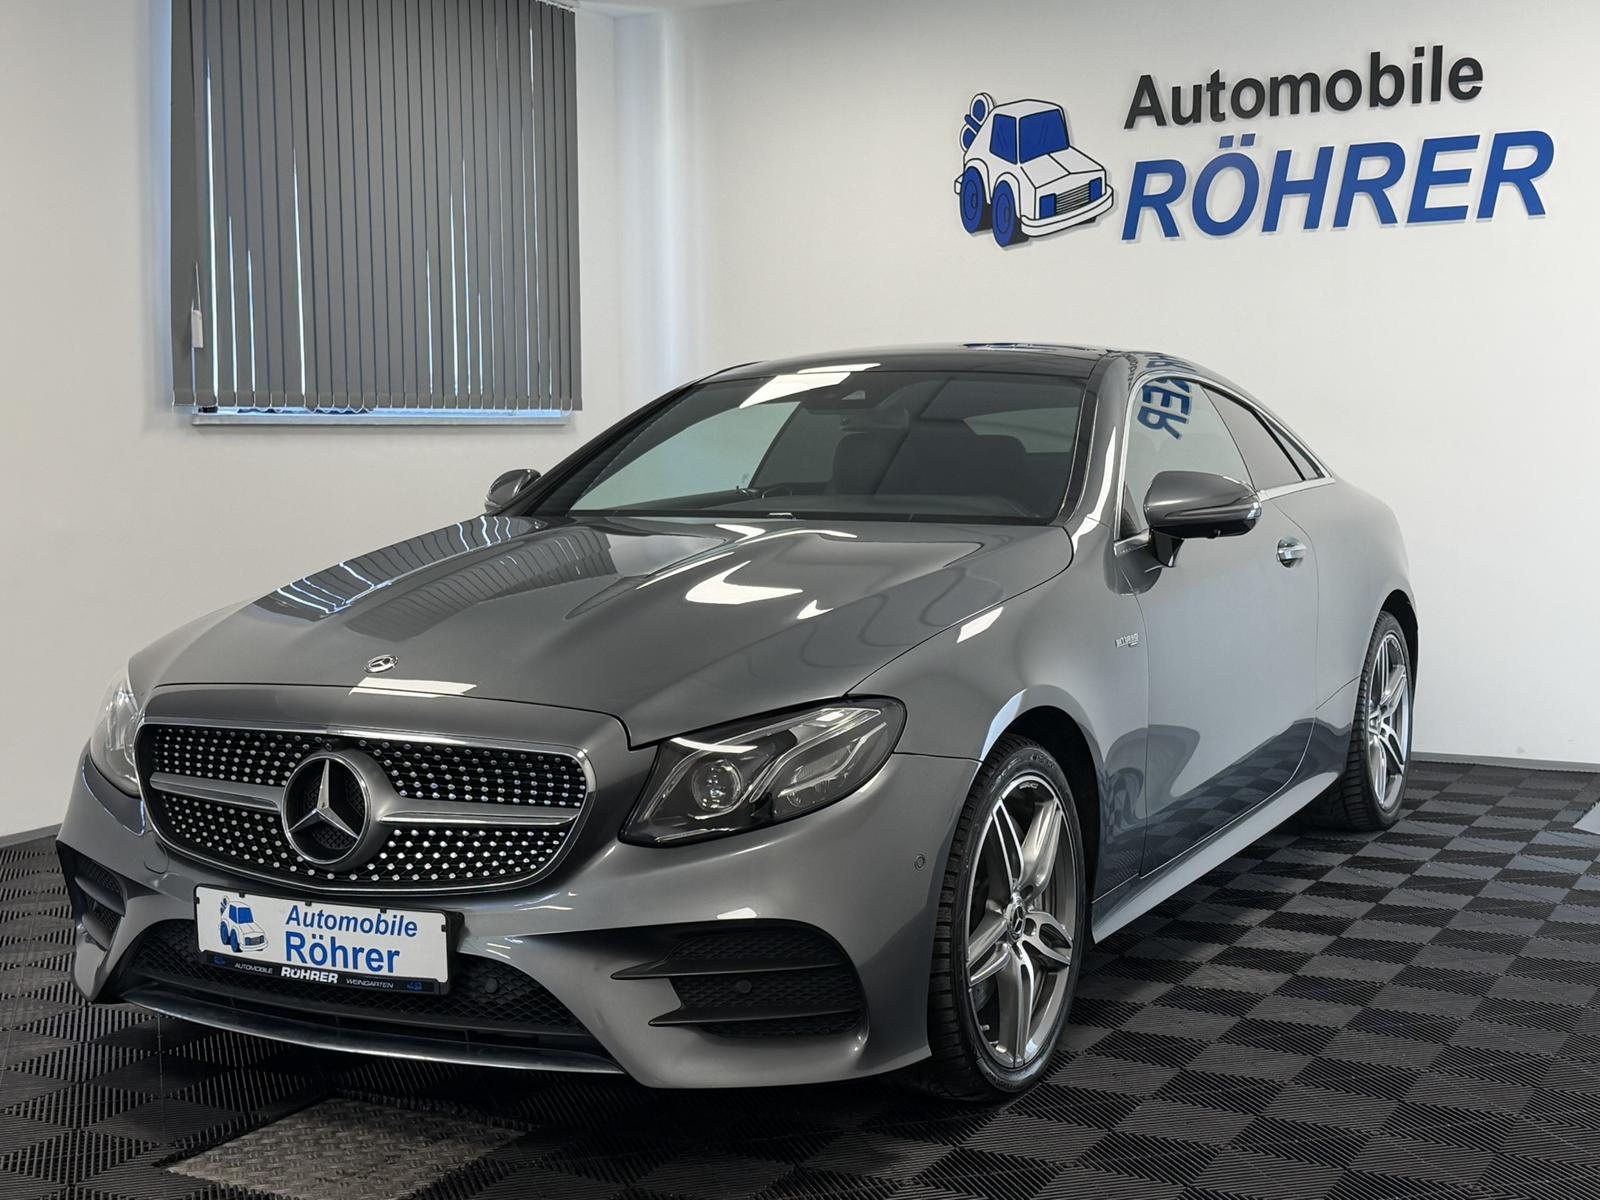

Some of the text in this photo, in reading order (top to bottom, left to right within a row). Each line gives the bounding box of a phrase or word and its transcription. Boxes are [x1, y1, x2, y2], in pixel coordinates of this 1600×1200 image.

[1123, 45, 1484, 129] Automobile
[1121, 131, 1555, 241] RÖHRER
[285, 904, 418, 937] Automobile
[285, 931, 400, 973] Röhrer
[234, 962, 394, 989] AUTOMOBILE RÖHRER WEINGARTEN
